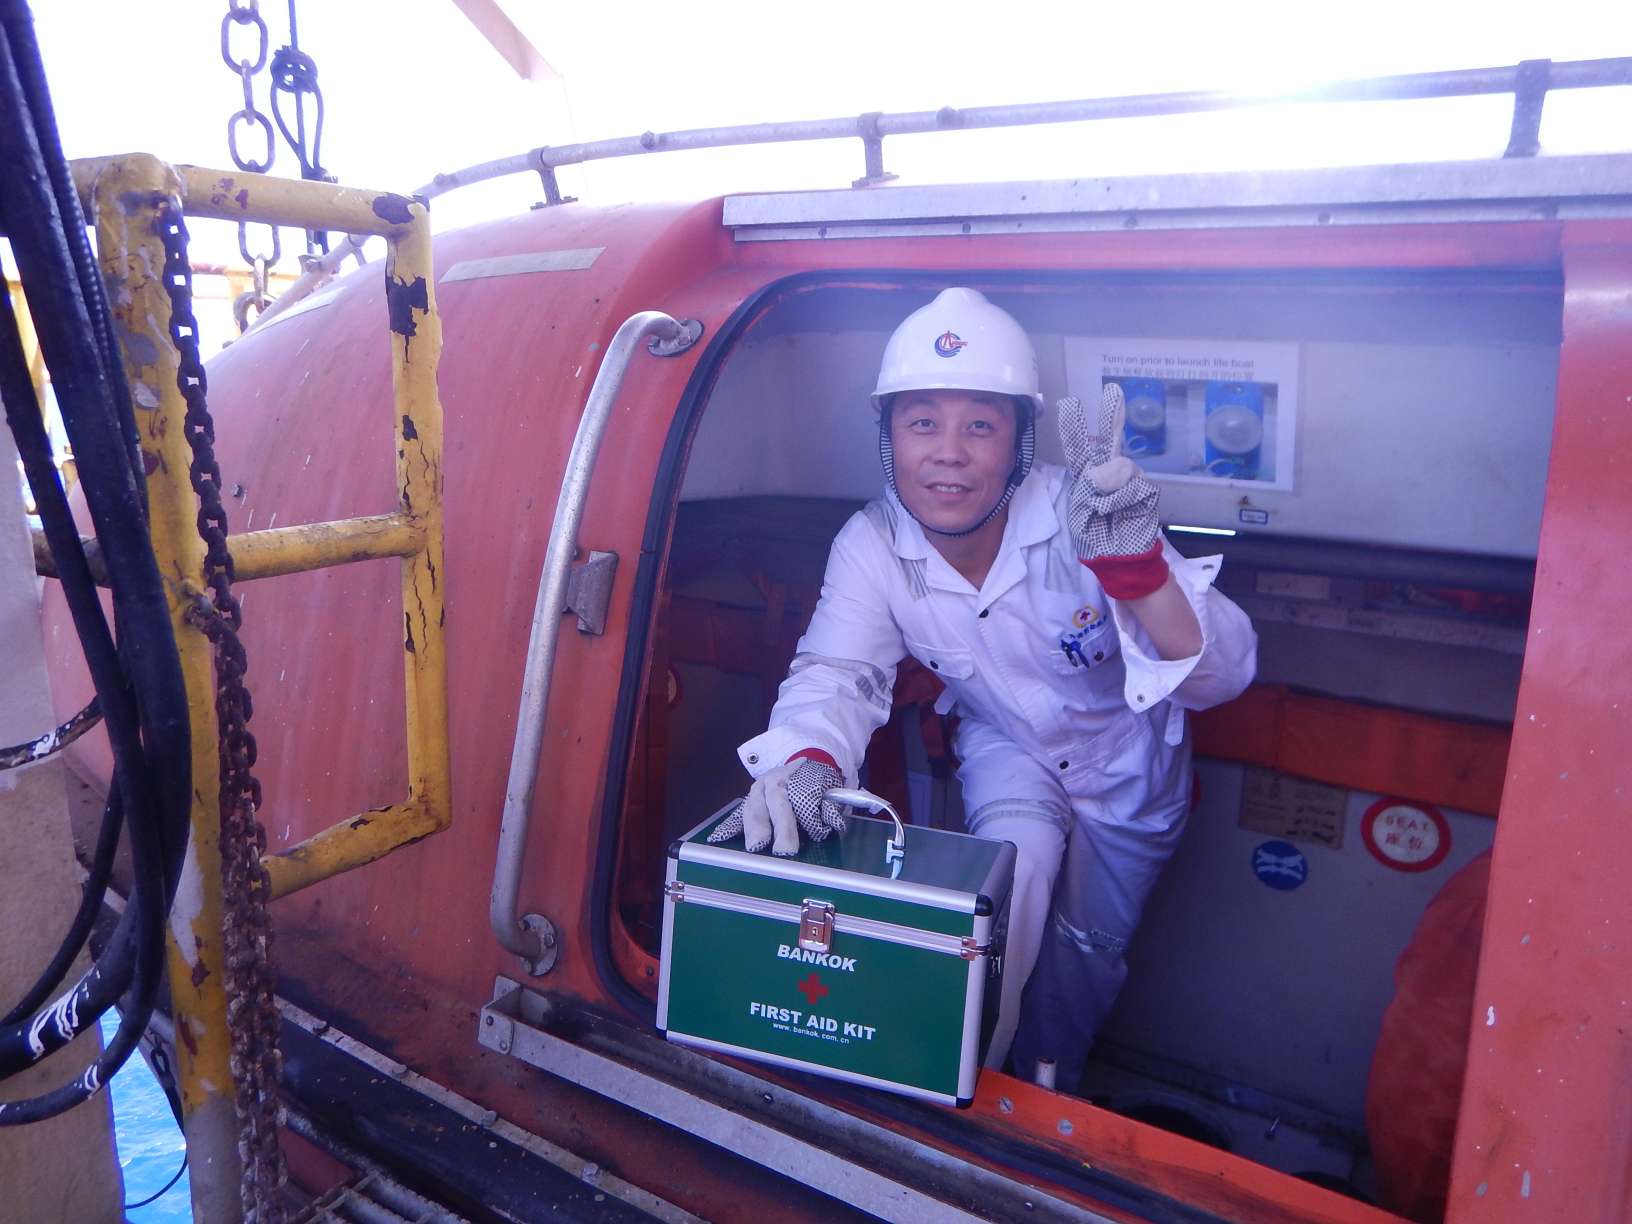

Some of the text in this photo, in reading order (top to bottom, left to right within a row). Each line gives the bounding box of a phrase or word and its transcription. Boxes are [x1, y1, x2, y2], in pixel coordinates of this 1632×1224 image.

[1102, 354, 1123, 364] Turn
[1140, 356, 1162, 368] prior
[1165, 357, 1175, 366] to
[1177, 356, 1210, 367] launch
[1231, 359, 1254, 368] boat
[777, 944, 857, 972] BANKOK
[750, 1001, 876, 1040] FIRST AID KIT
